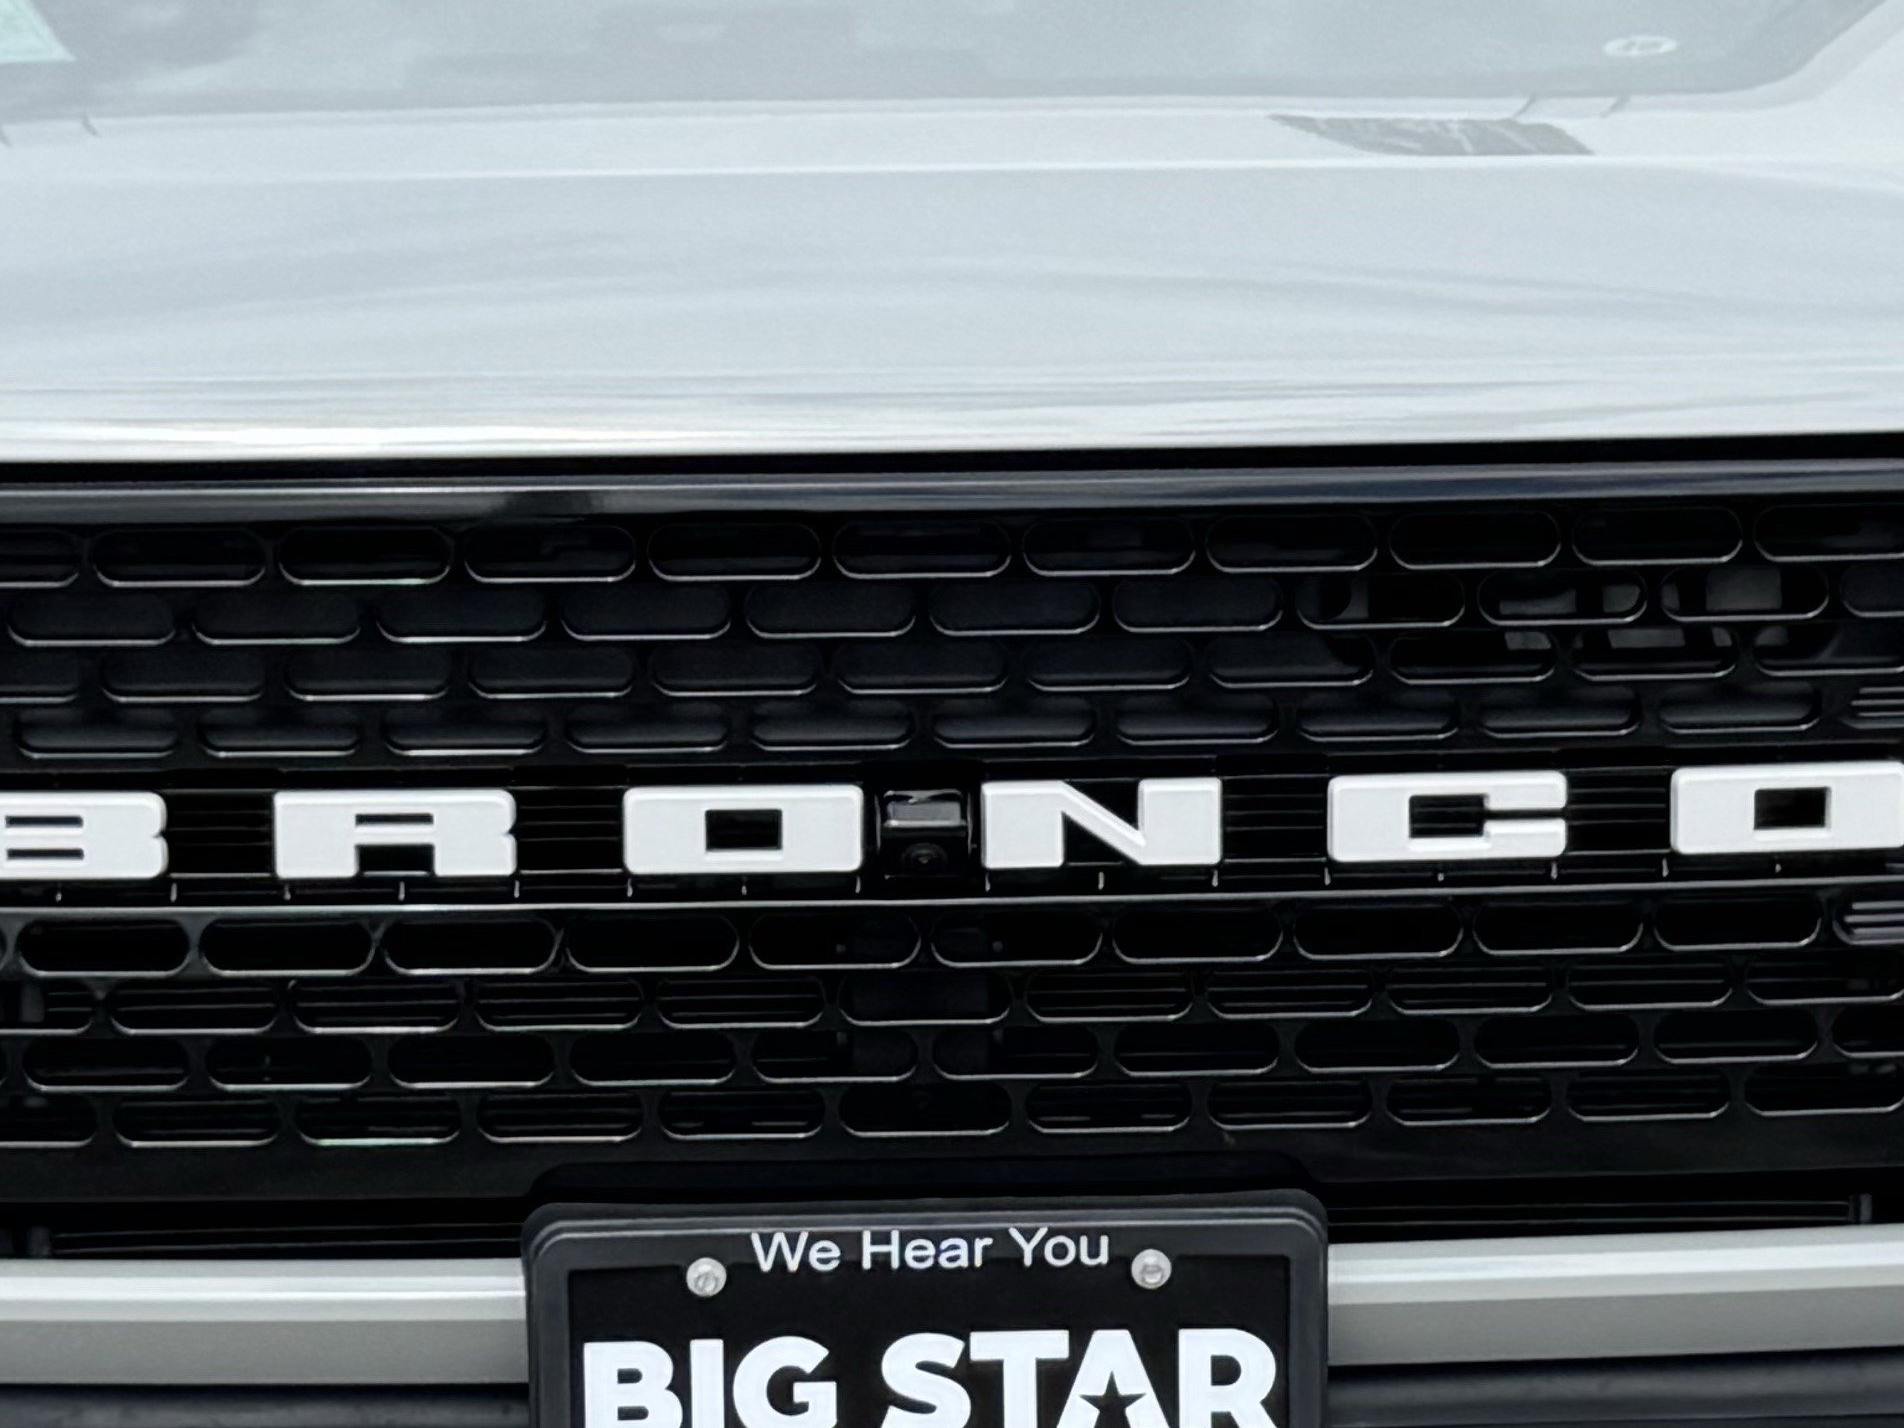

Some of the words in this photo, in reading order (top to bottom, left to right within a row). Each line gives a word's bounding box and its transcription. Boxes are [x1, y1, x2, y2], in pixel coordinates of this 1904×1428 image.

[750, 1231, 841, 1272] We
[861, 1229, 994, 1270] Hear
[1007, 1226, 1109, 1267] You
